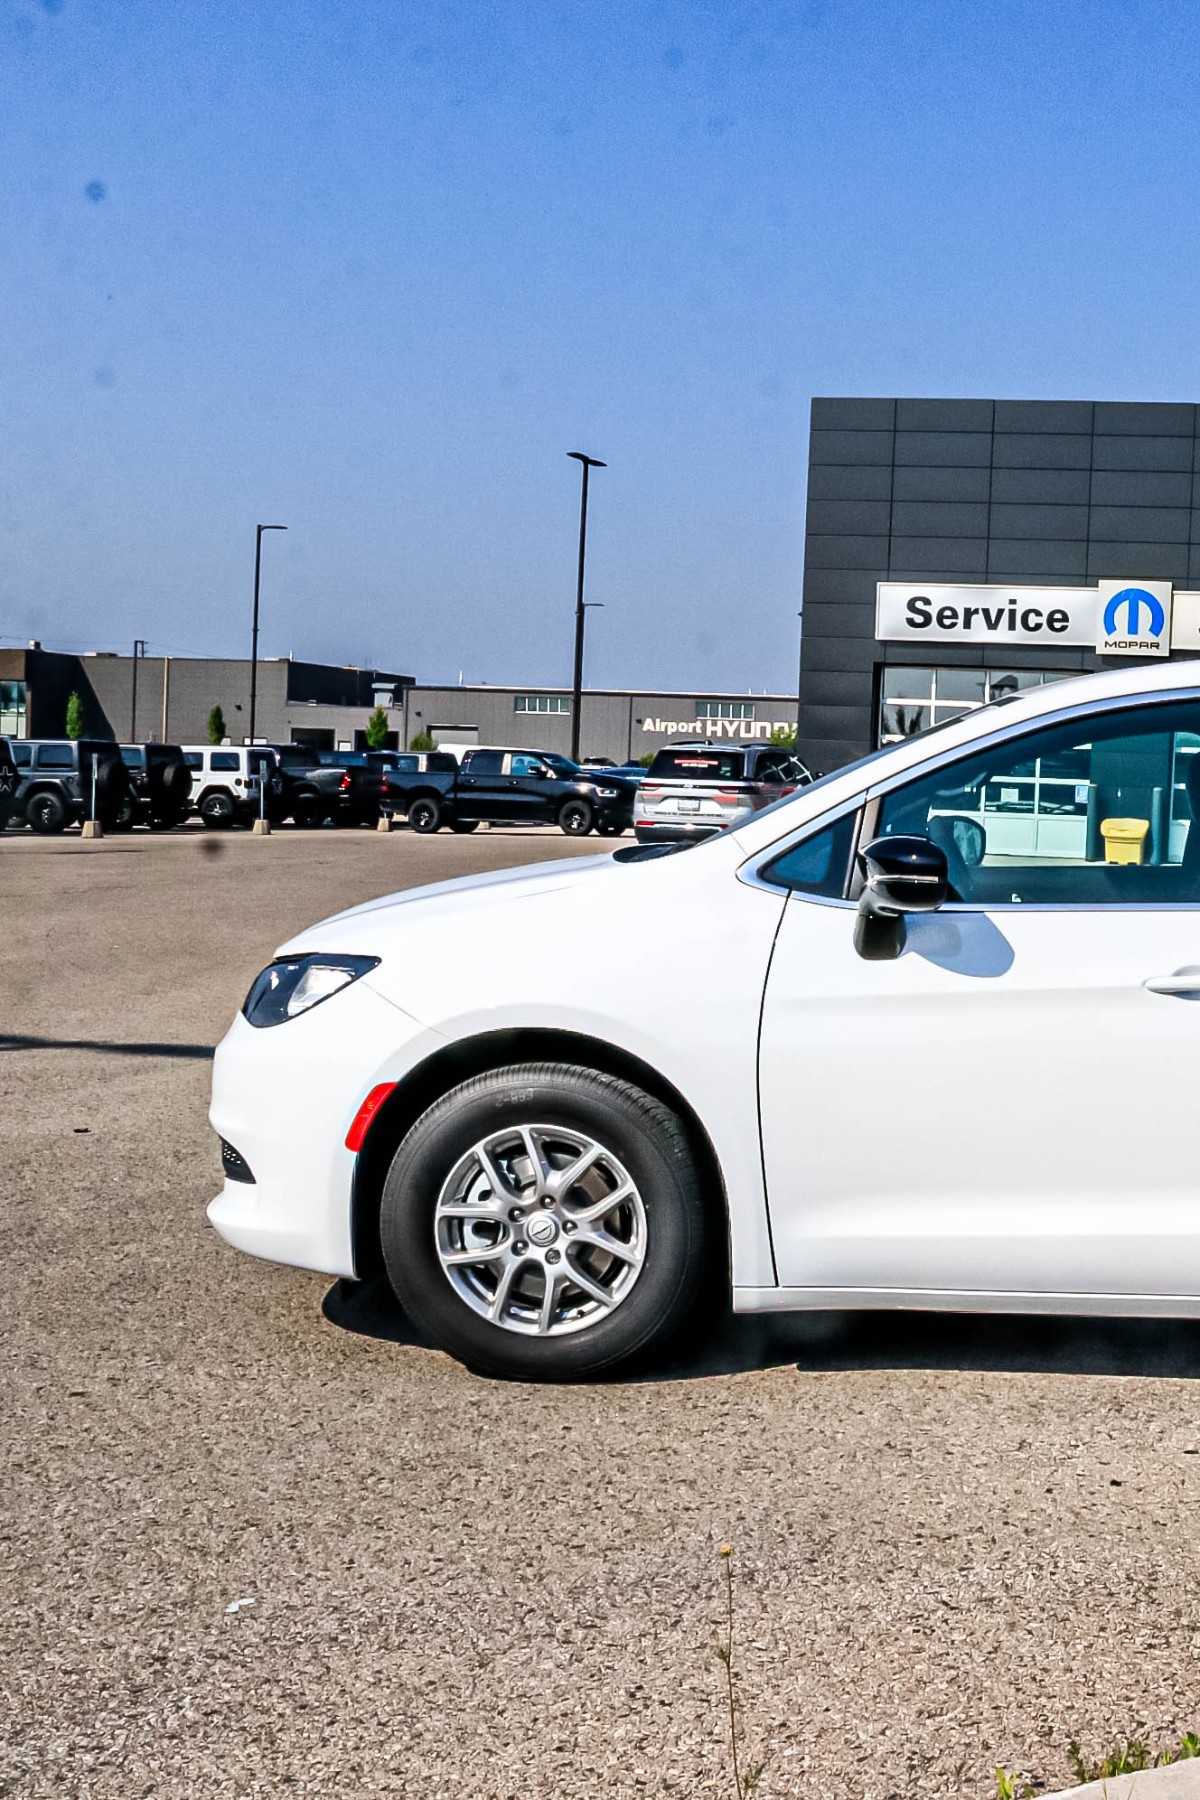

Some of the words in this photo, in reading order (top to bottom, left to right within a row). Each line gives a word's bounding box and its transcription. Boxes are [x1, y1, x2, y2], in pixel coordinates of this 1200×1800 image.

[905, 595, 1070, 634] Service
[1104, 640, 1161, 651] MOPAR
[642, 718, 703, 735] Airport
